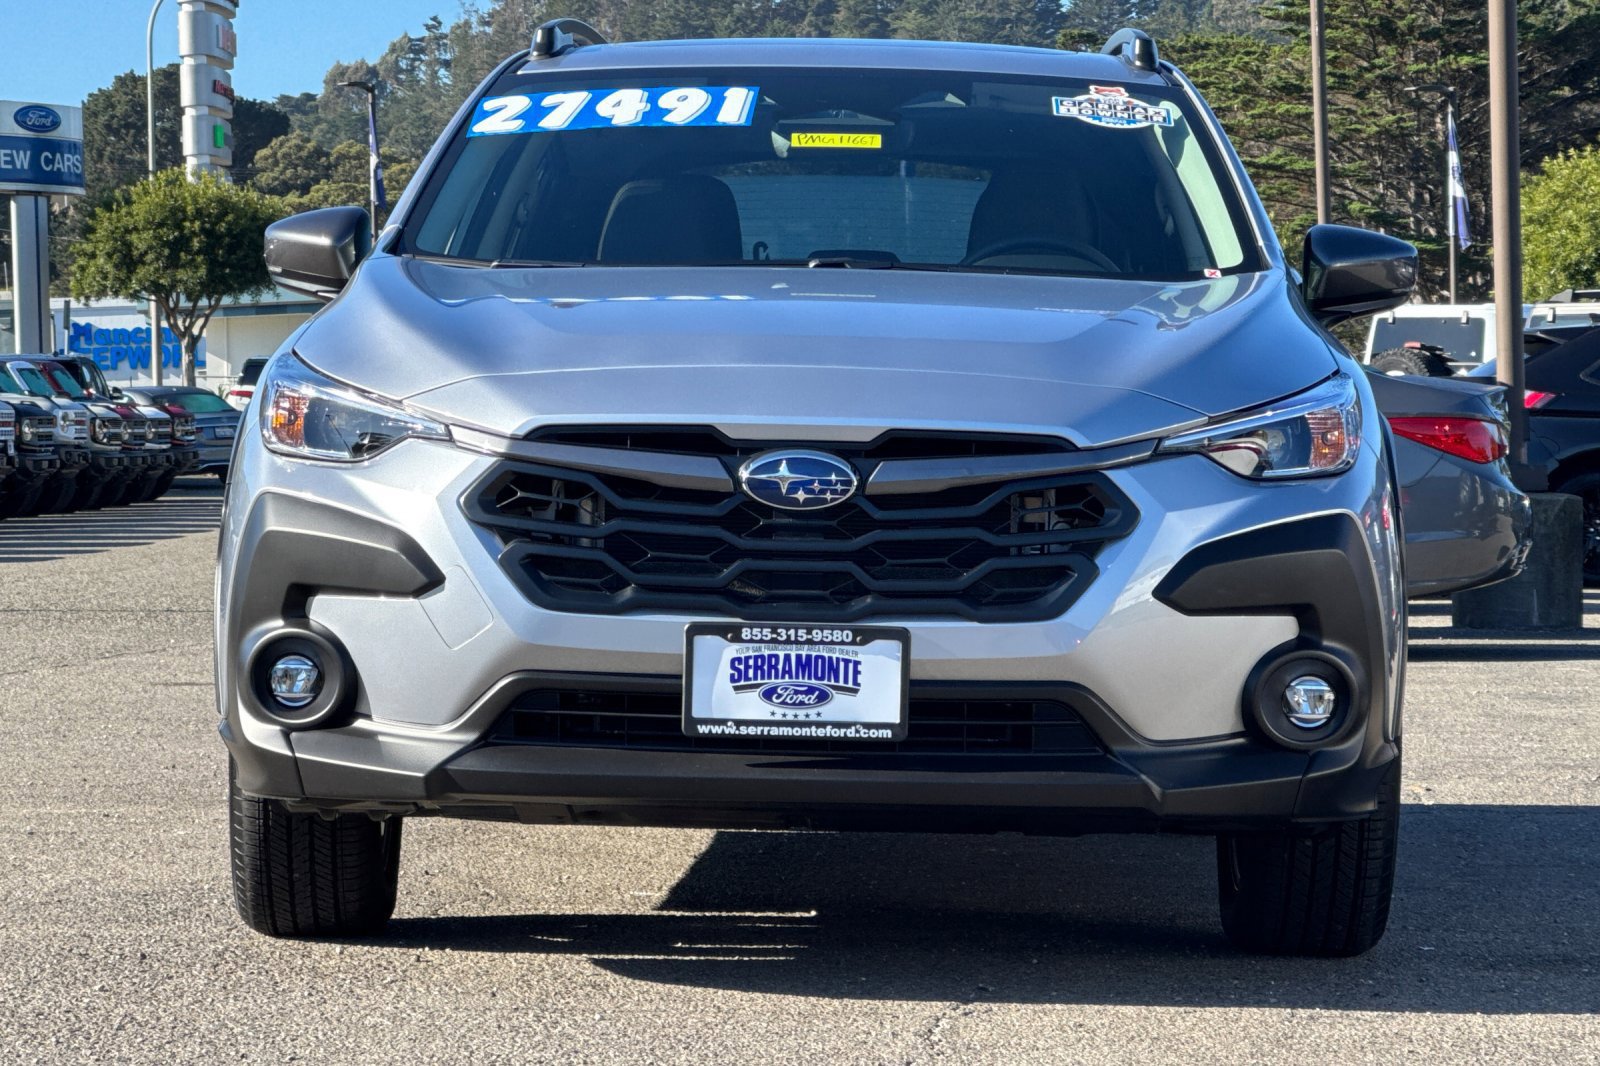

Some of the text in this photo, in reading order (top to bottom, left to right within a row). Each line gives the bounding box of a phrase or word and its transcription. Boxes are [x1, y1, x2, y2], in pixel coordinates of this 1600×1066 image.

[471, 87, 756, 134] 27491
[1061, 99, 1166, 116] CARFAX
[1080, 108, 1164, 123] OWNER
[26, 110, 53, 127] Ford
[0, 149, 82, 174] EW CARS
[741, 627, 854, 643] 855-315-9580
[735, 644, 859, 658] YOUR SAN FRANCISCO BAY AREA FORD DEALER
[729, 653, 862, 687] SERRAMONTE
[771, 685, 819, 705] Ford
[697, 723, 893, 738] www.serramonteford.com
